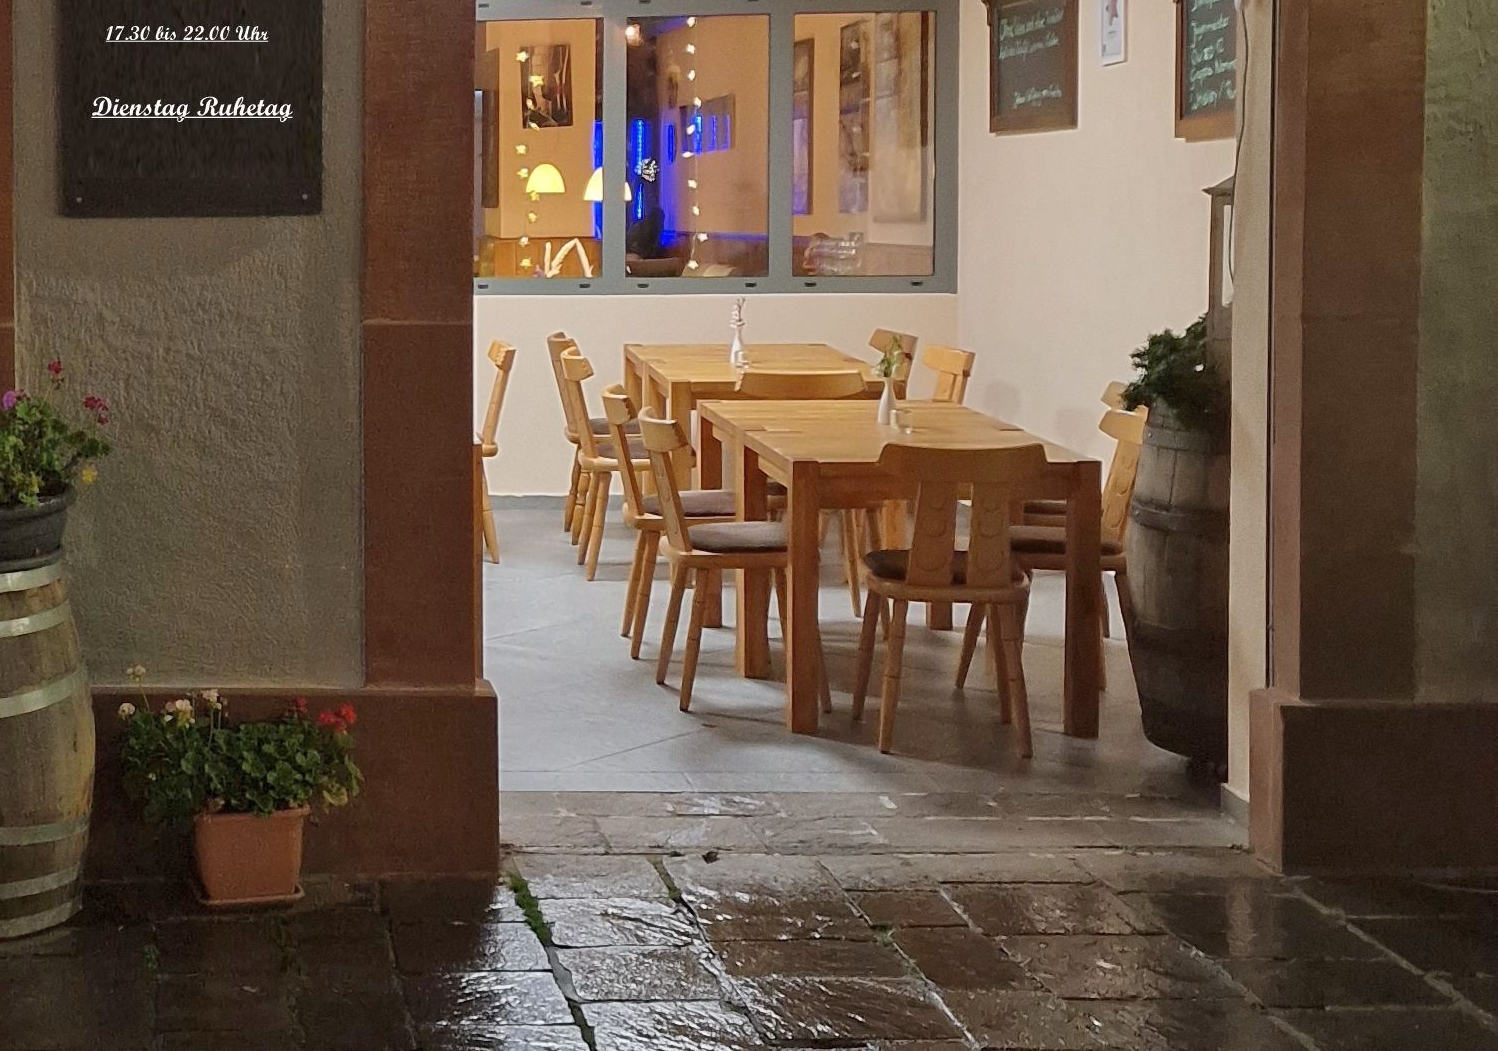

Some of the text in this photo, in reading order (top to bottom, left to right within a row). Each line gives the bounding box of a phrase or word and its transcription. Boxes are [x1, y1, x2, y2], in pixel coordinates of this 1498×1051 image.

[105, 25, 269, 42] 17.30 bis 22.00 Uhr
[92, 95, 293, 122] Dienstag Ruhetag
